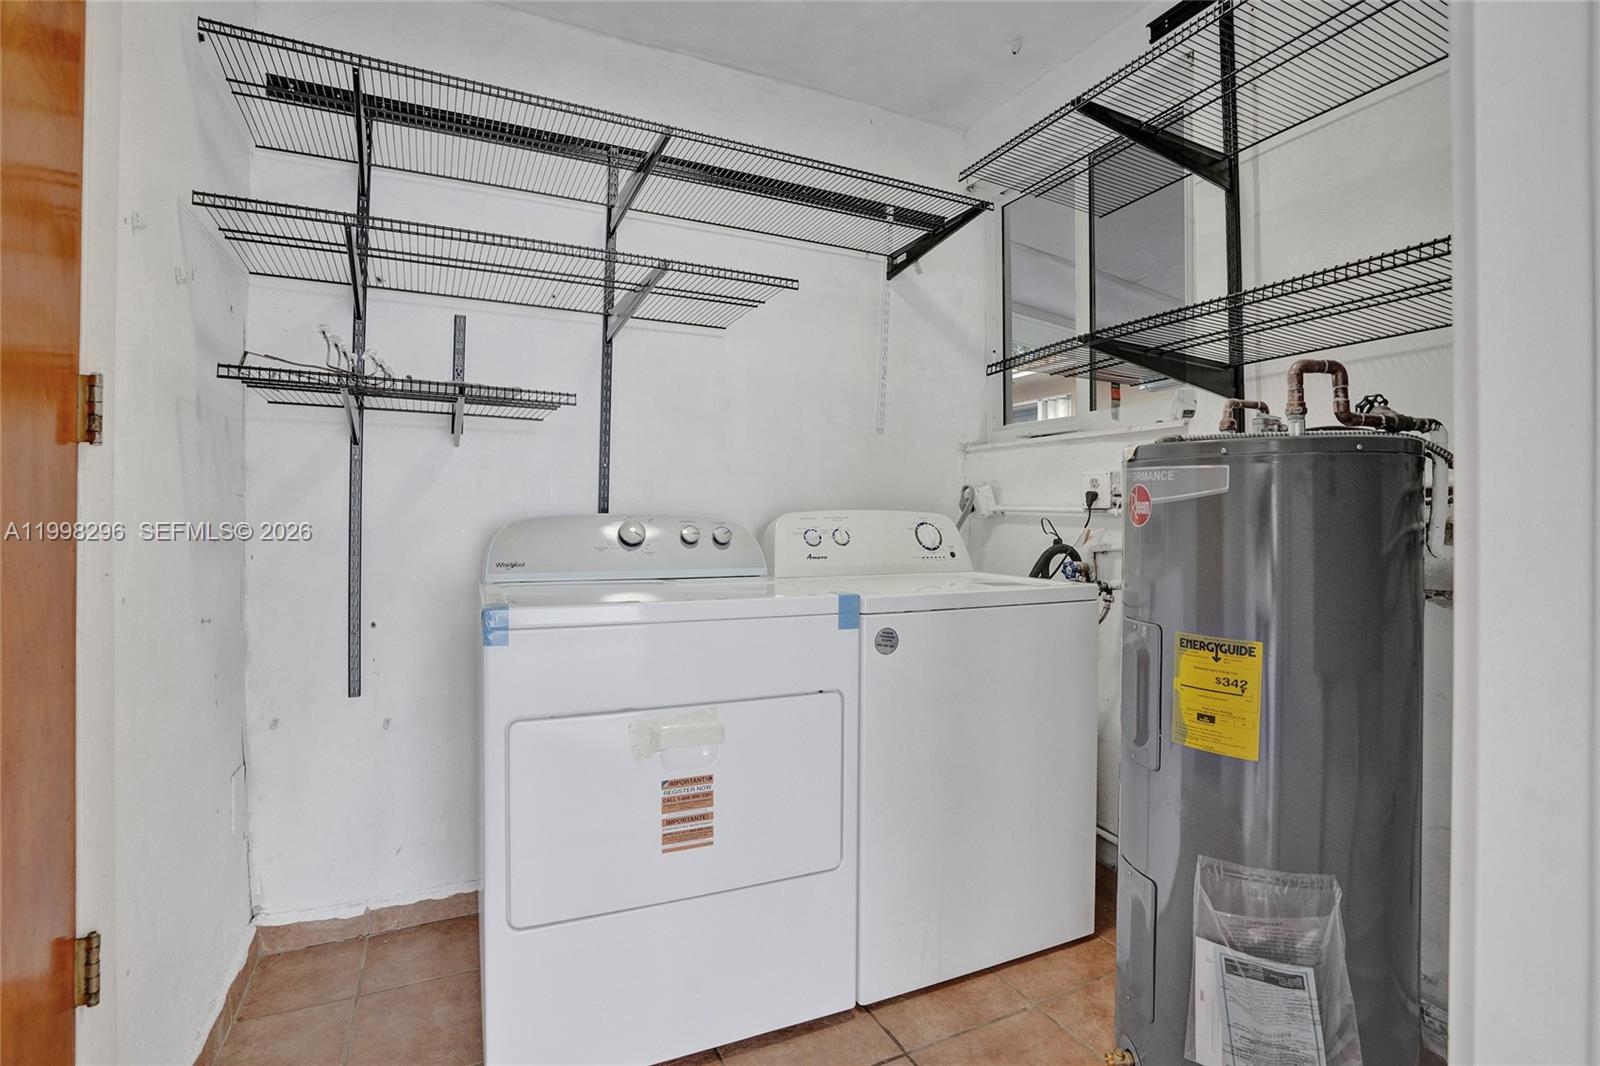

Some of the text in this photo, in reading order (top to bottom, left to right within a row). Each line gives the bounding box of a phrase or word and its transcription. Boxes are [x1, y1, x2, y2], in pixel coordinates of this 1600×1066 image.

[495, 561, 526, 571] Whirlpool
[1215, 676, 1249, 690] $342
[663, 784, 712, 796] REGISTER NOW
[662, 796, 676, 804] CALL
[665, 814, 709, 825] IMPORTANTE!
